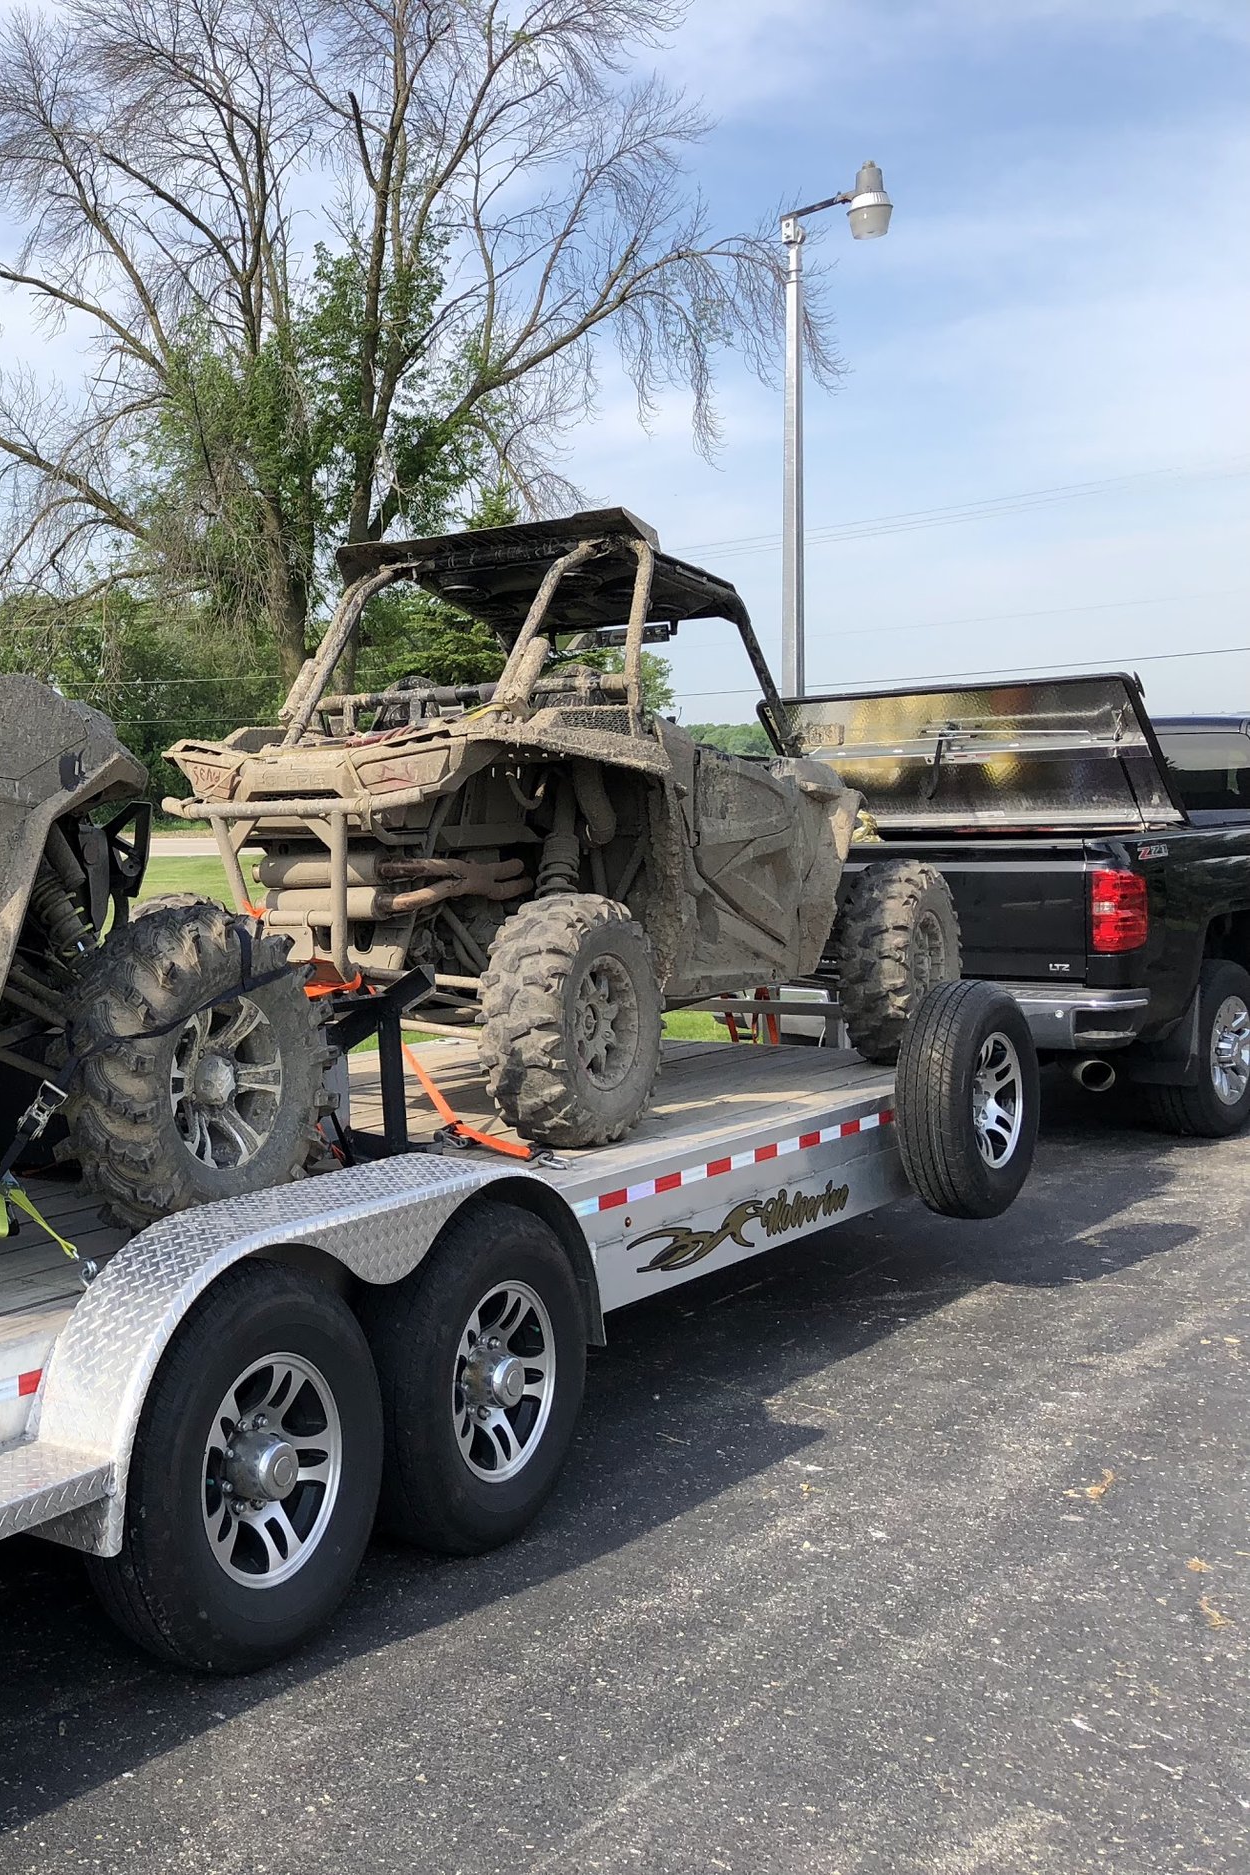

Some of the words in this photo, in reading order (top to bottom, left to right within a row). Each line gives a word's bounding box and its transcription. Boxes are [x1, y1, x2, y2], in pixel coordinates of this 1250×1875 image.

[1137, 843, 1169, 860] Z71
[1049, 963, 1070, 972] LTZ
[762, 1179, 849, 1237] Wolverine
